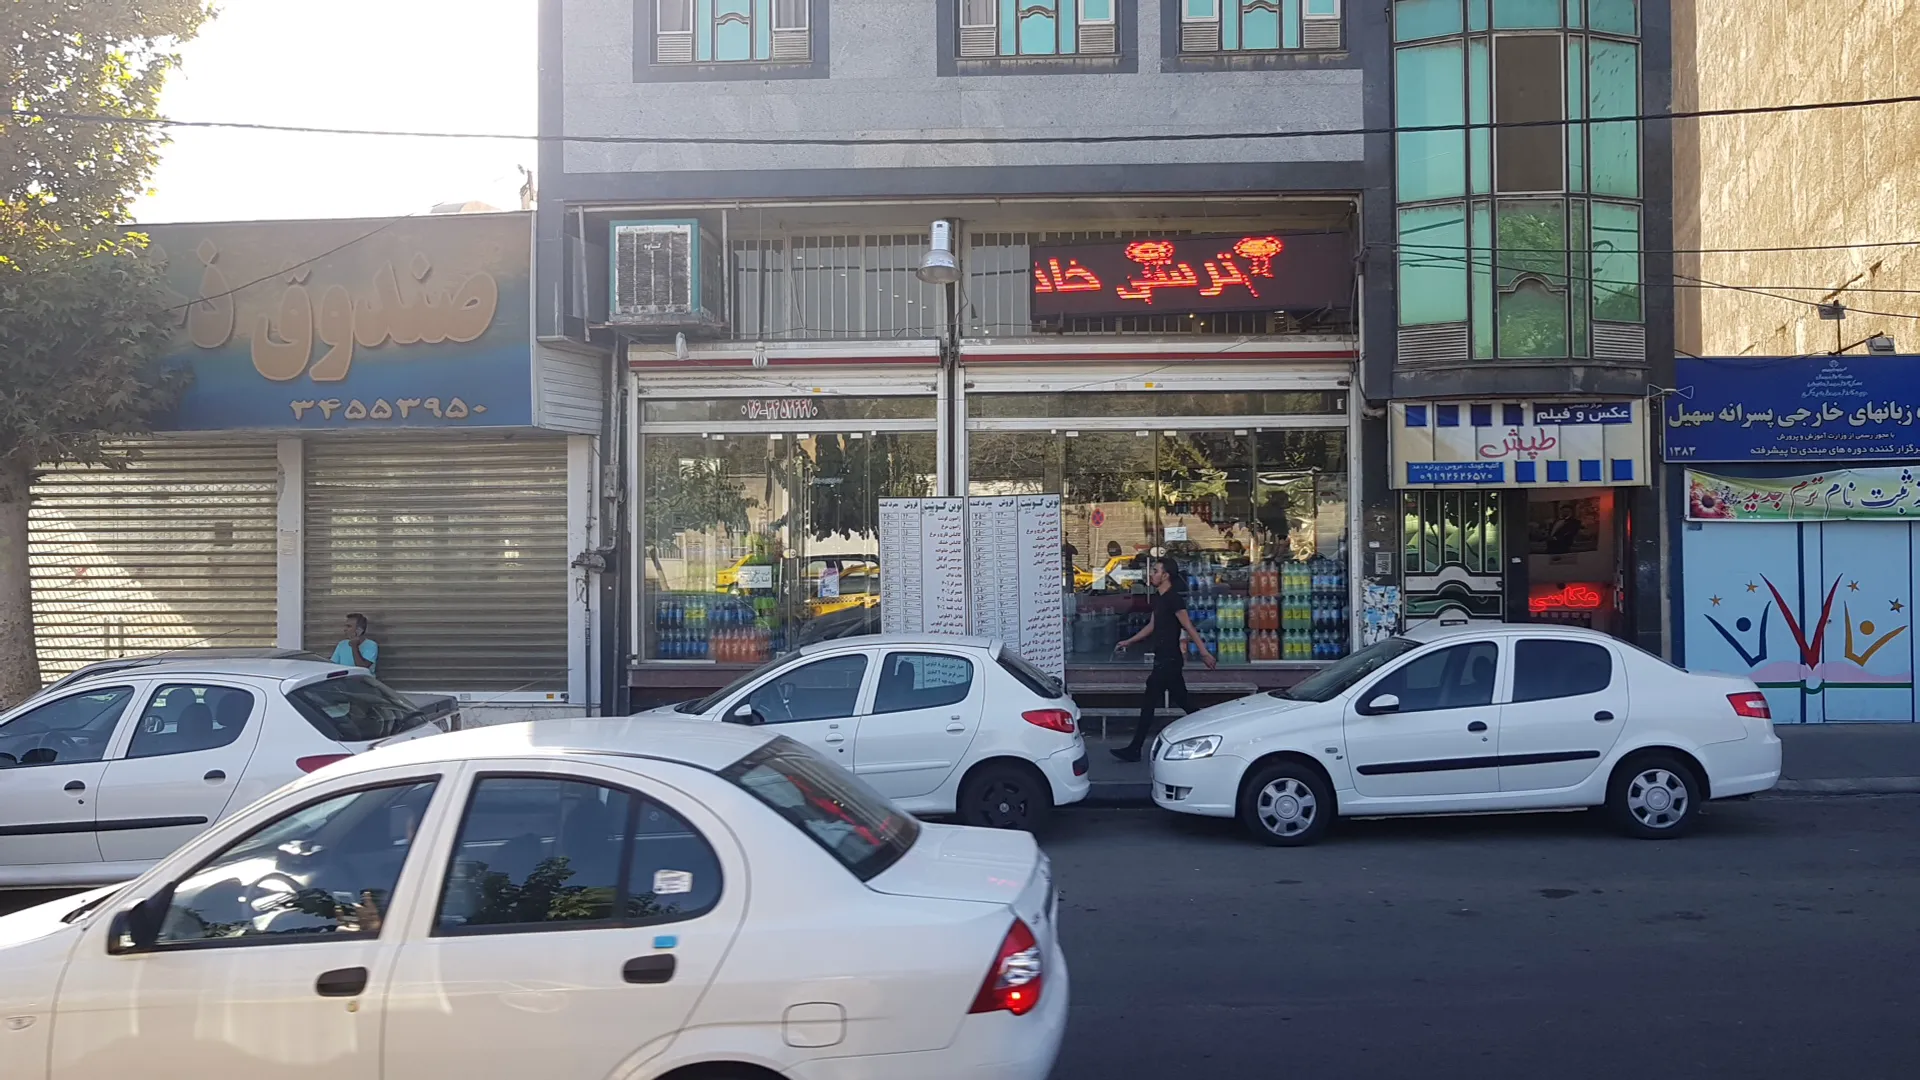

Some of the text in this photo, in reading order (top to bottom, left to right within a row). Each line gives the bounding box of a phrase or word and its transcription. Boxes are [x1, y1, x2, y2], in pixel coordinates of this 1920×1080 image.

[251, 252, 498, 380] صندوق
[289, 396, 488, 420] ۳۴۵۵۳۹۵۰
[1537, 407, 1629, 423] عکس و فیلم
[1668, 403, 1715, 427] سهیل
[1719, 402, 1774, 429] پسرانه
[1778, 401, 1844, 428] خارجی
[1849, 400, 1913, 427] زبانهای
[1479, 428, 1556, 459] طپش
[1776, 434, 1799, 442] پرورش
[1805, 432, 1827, 440] آموزش
[1750, 447, 1788, 457] پیشرفته
[1790, 446, 1798, 454] تا
[1799, 447, 1827, 456] مبتدی
[1828, 446, 1846, 455] های
[1847, 446, 1868, 454] دوره
[1869, 444, 1894, 453] کننده
[1743, 489, 1784, 512] جدید
[1789, 476, 1824, 519] ترم
[1824, 481, 1856, 519] نام
[1860, 468, 1912, 514] ثبت
